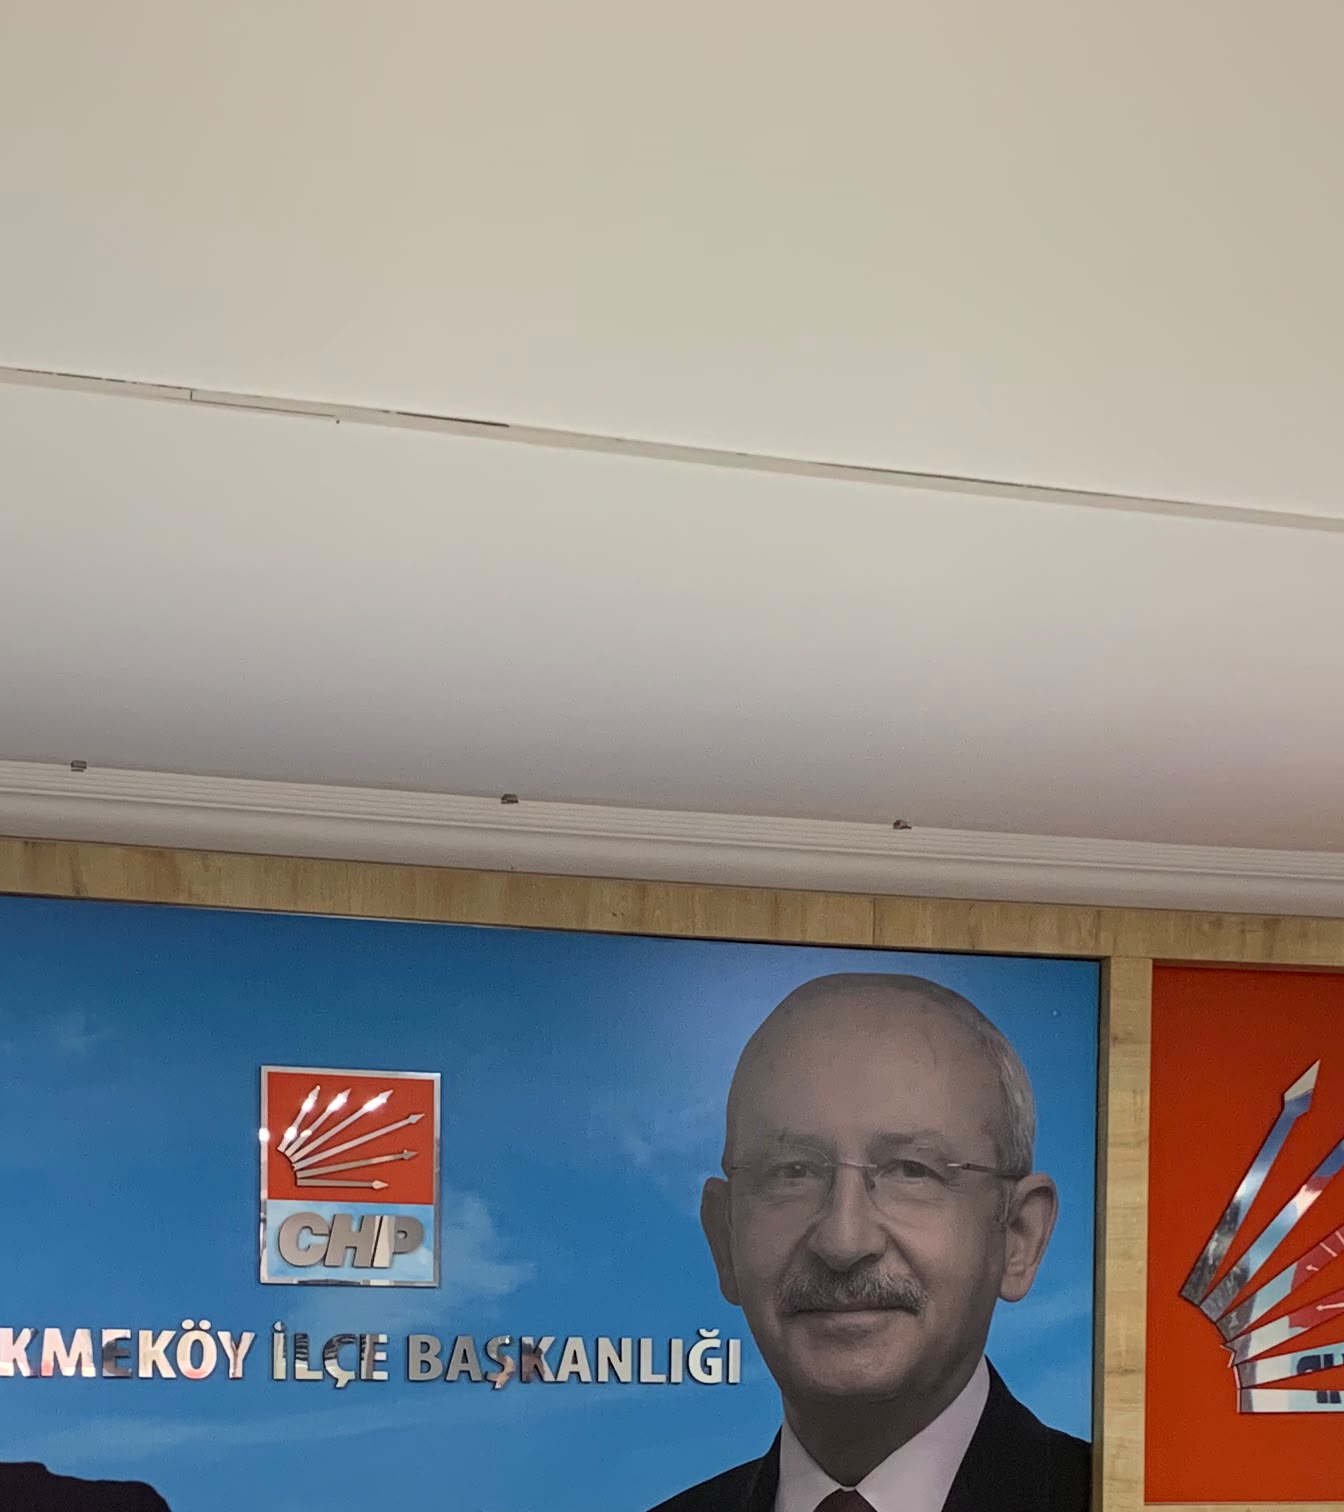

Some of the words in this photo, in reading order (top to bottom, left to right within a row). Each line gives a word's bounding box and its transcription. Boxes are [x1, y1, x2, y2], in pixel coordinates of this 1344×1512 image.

[275, 1211, 427, 1270] CHP
[270, 1320, 390, 1390] İLÇE
[406, 1328, 742, 1391] BAŞKANLIĞI
